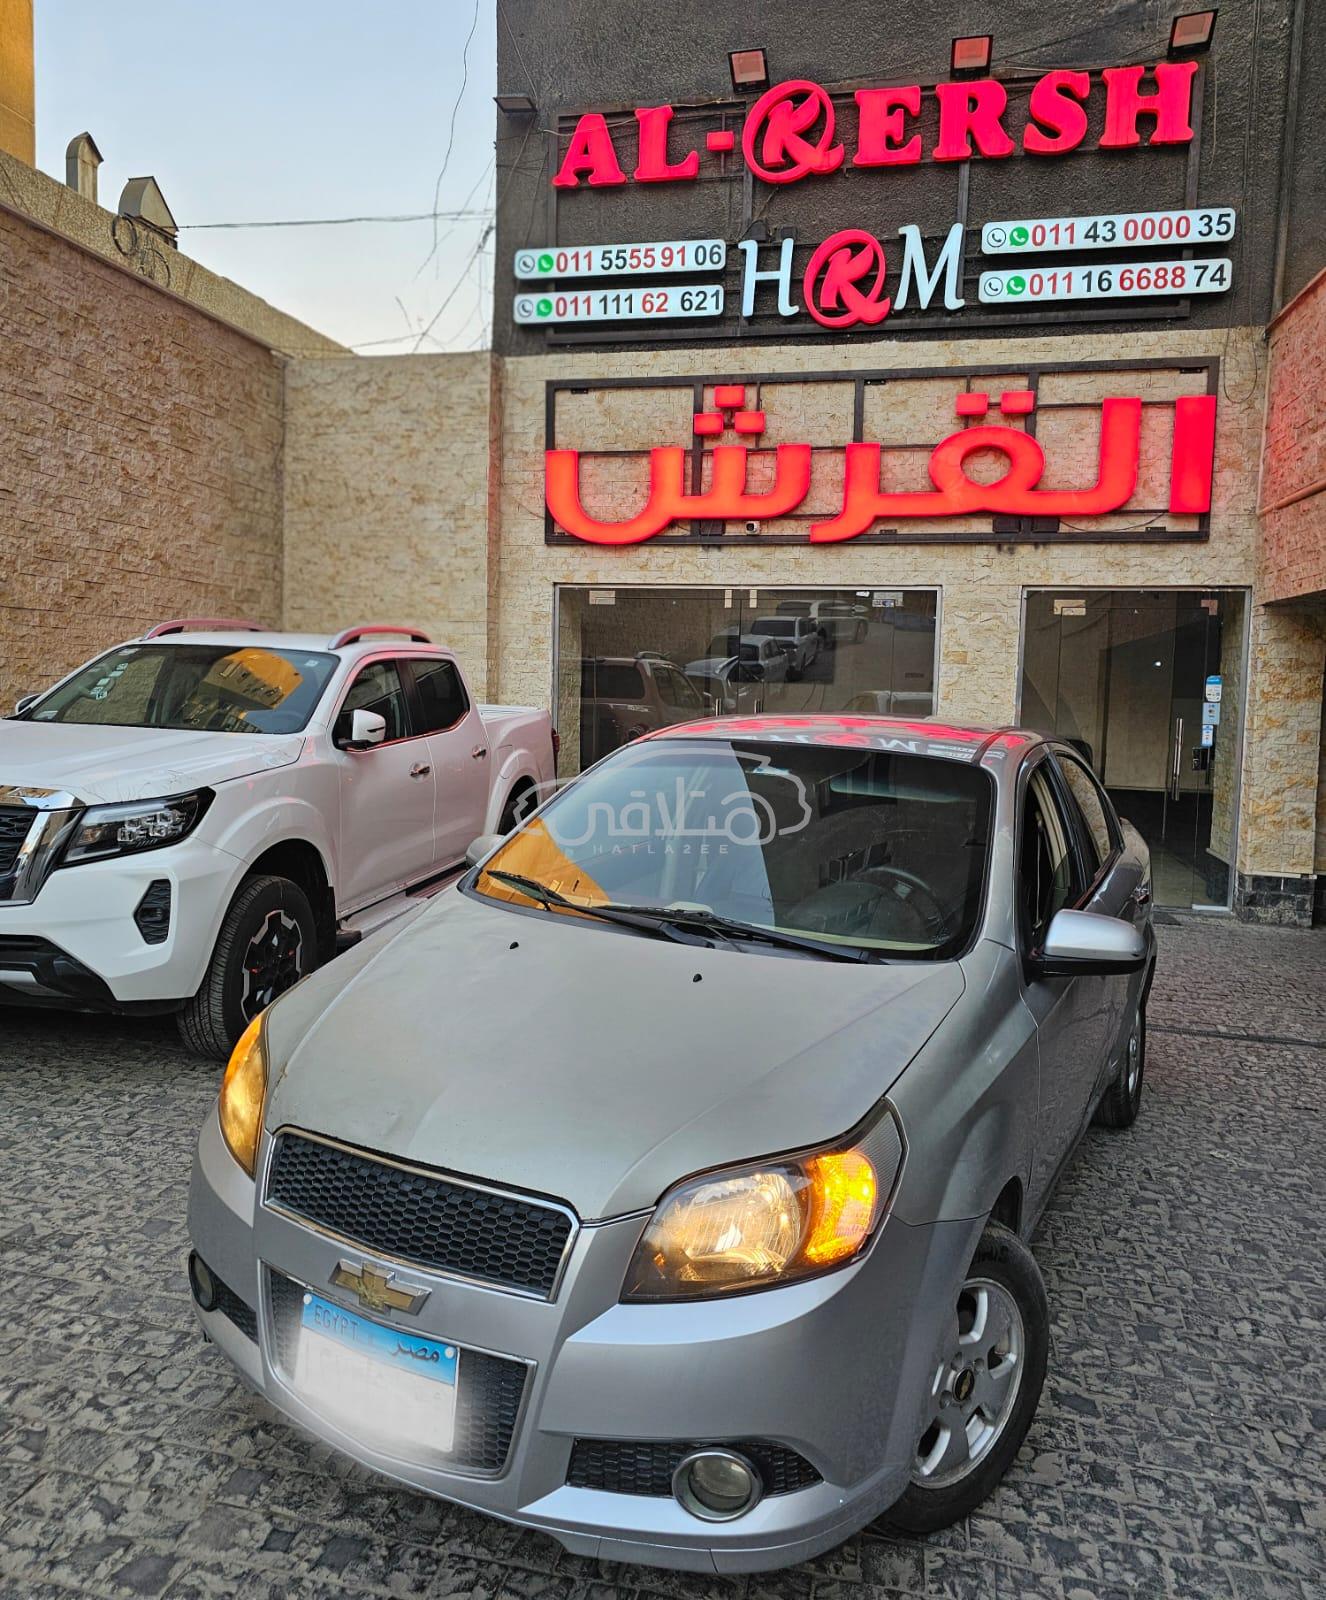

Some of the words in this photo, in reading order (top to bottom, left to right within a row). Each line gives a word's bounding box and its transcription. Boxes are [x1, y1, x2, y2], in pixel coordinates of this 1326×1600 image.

[1031, 222, 1076, 247] 011
[1084, 221, 1116, 243] 43
[1123, 215, 1191, 242] 0000
[1198, 213, 1232, 237] 35
[556, 250, 593, 273] 011
[694, 244, 722, 266] 06
[1029, 272, 1073, 296] 011
[1081, 269, 1113, 293] 16
[1119, 265, 1186, 291] 6688
[1193, 263, 1227, 288] 74
[555, 295, 593, 317] 011
[599, 293, 634, 315] 111
[641, 292, 669, 314] 62
[680, 289, 720, 312] 621
[545, 385, 1217, 545] القرش
[313, 1303, 360, 1341] EGYPT
[388, 1340, 440, 1363] مصر
